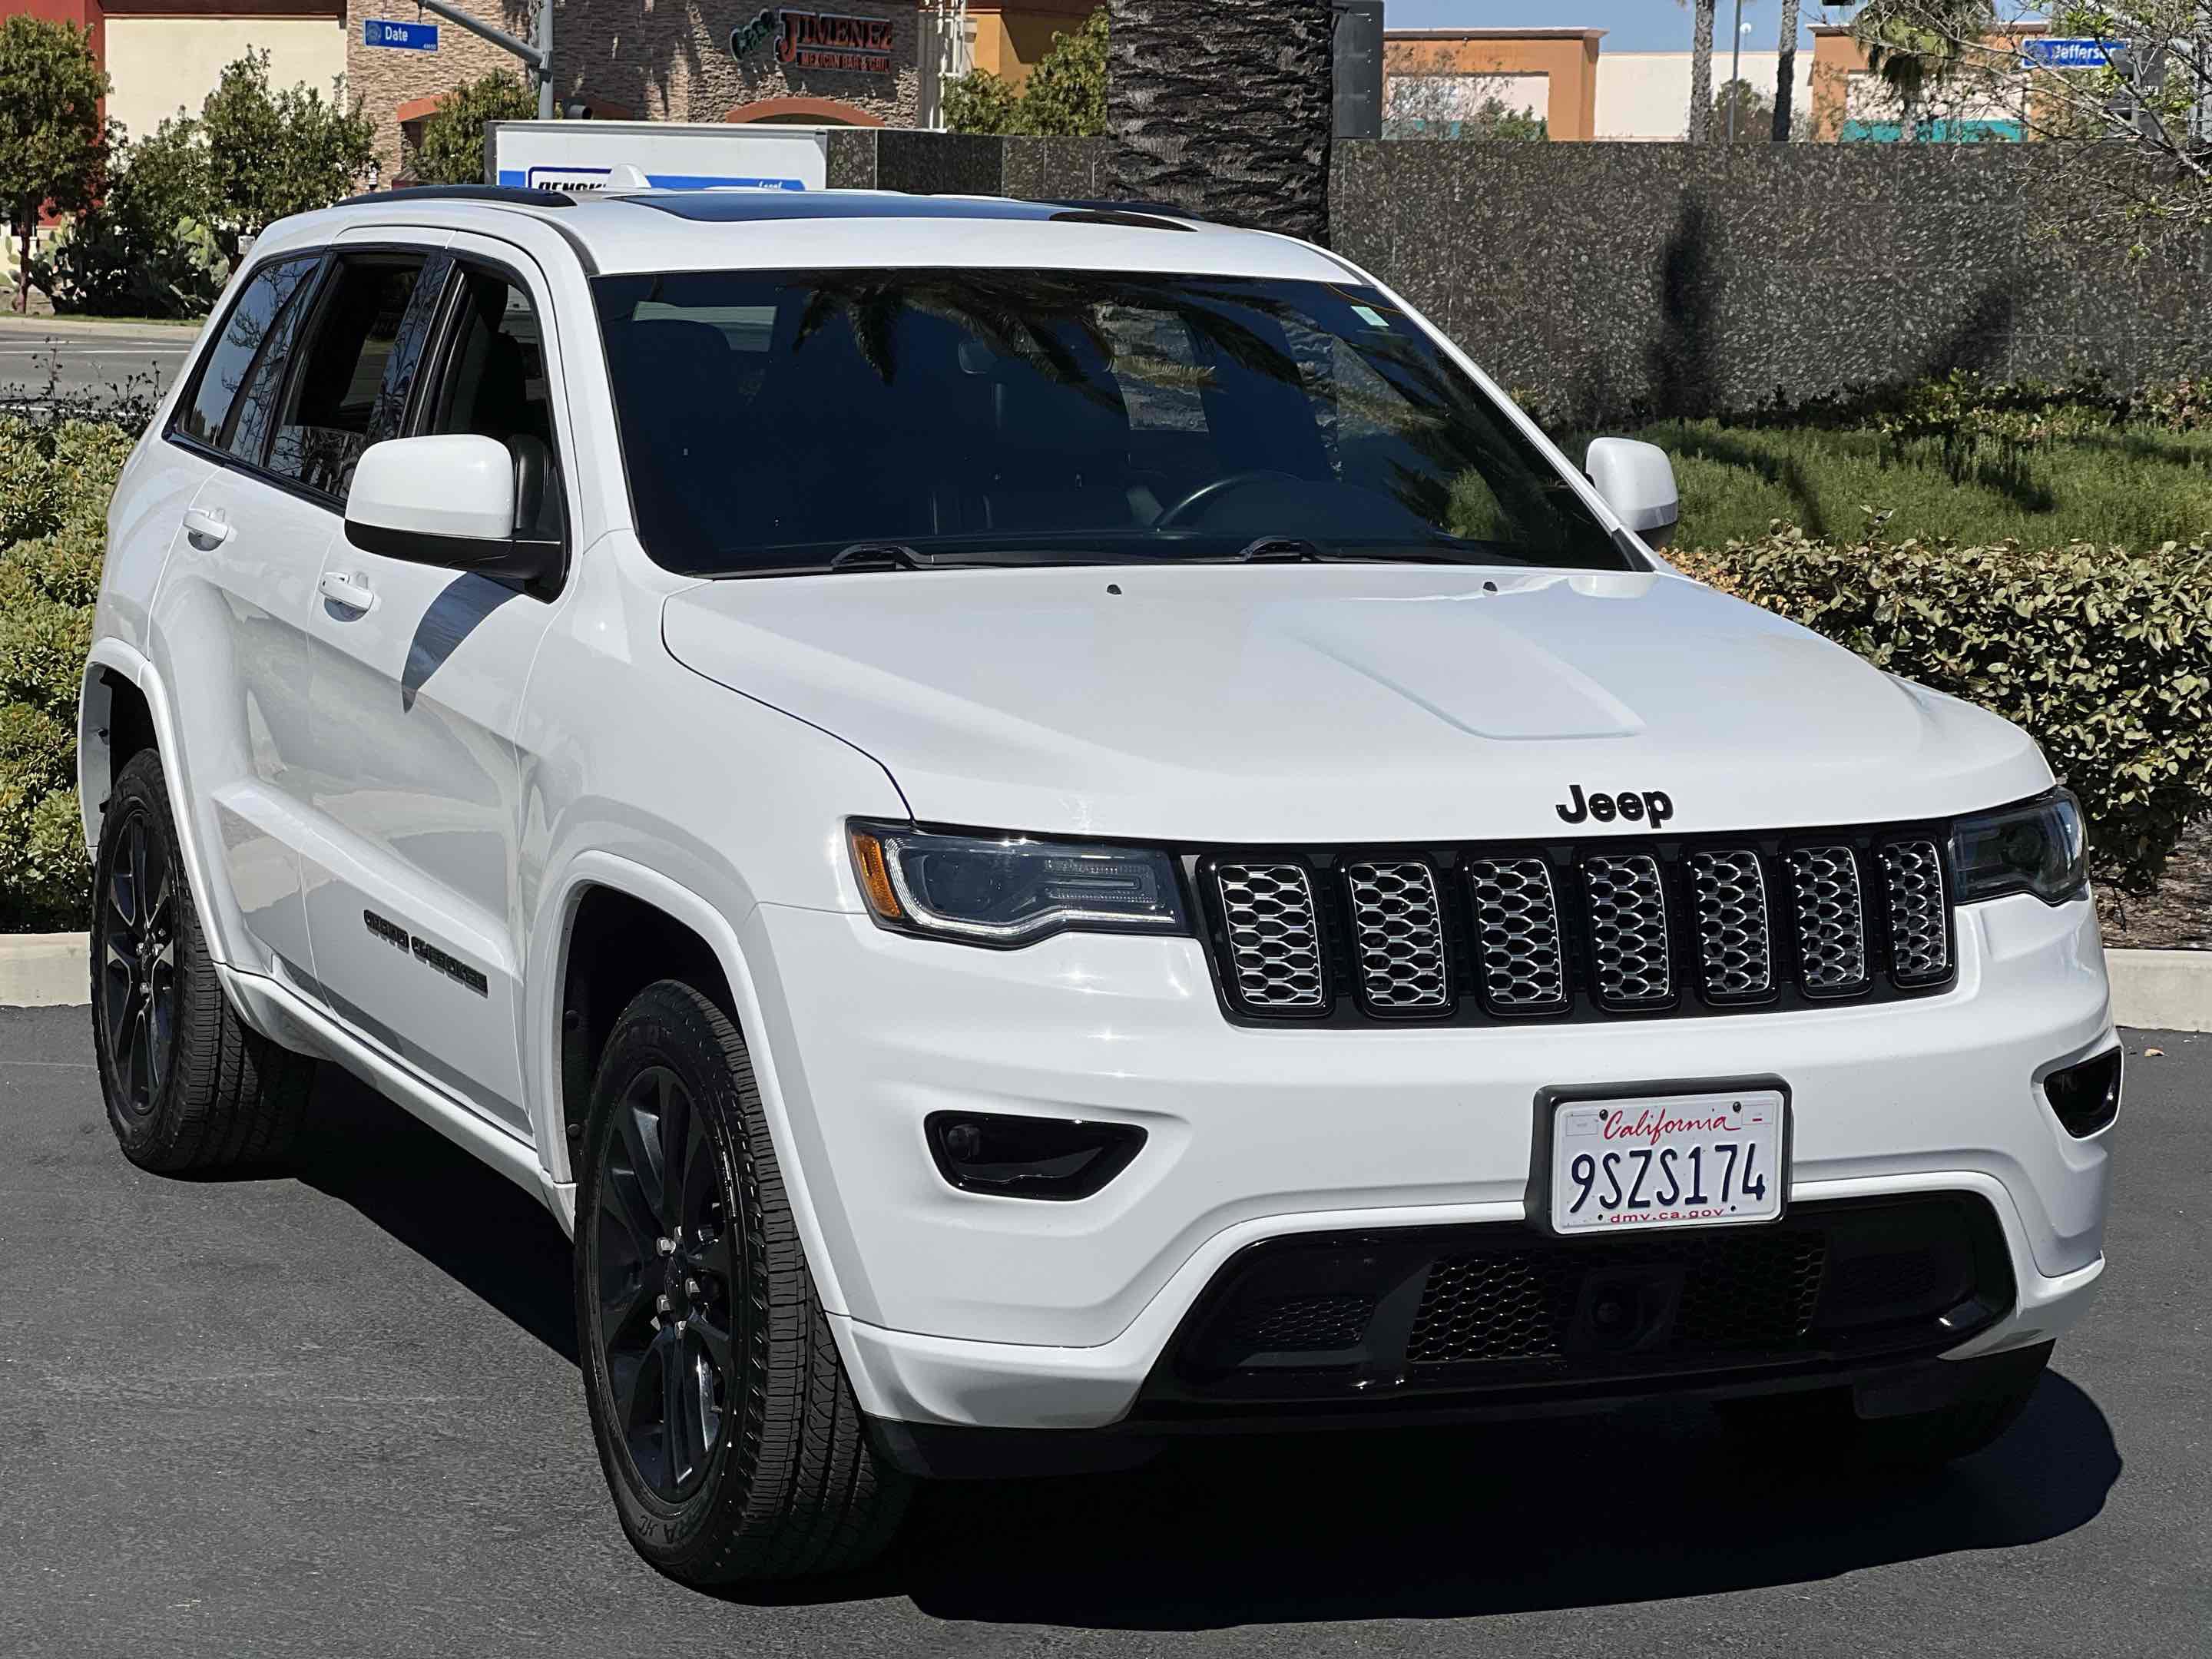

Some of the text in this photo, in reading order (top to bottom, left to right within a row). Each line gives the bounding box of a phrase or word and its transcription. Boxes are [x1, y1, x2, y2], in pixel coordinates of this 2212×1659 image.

[385, 26, 409, 41] Date
[774, 8, 893, 63] JIMENEZ
[800, 52, 840, 69] MEXICAN
[842, 54, 861, 70] BAR
[861, 56, 868, 71] &
[1555, 784, 1674, 830] Jeep
[1603, 1108, 1741, 1145] California
[1569, 1143, 1766, 1214] 9SZS174
[1610, 1209, 1725, 1224] dmv.ca.gov
